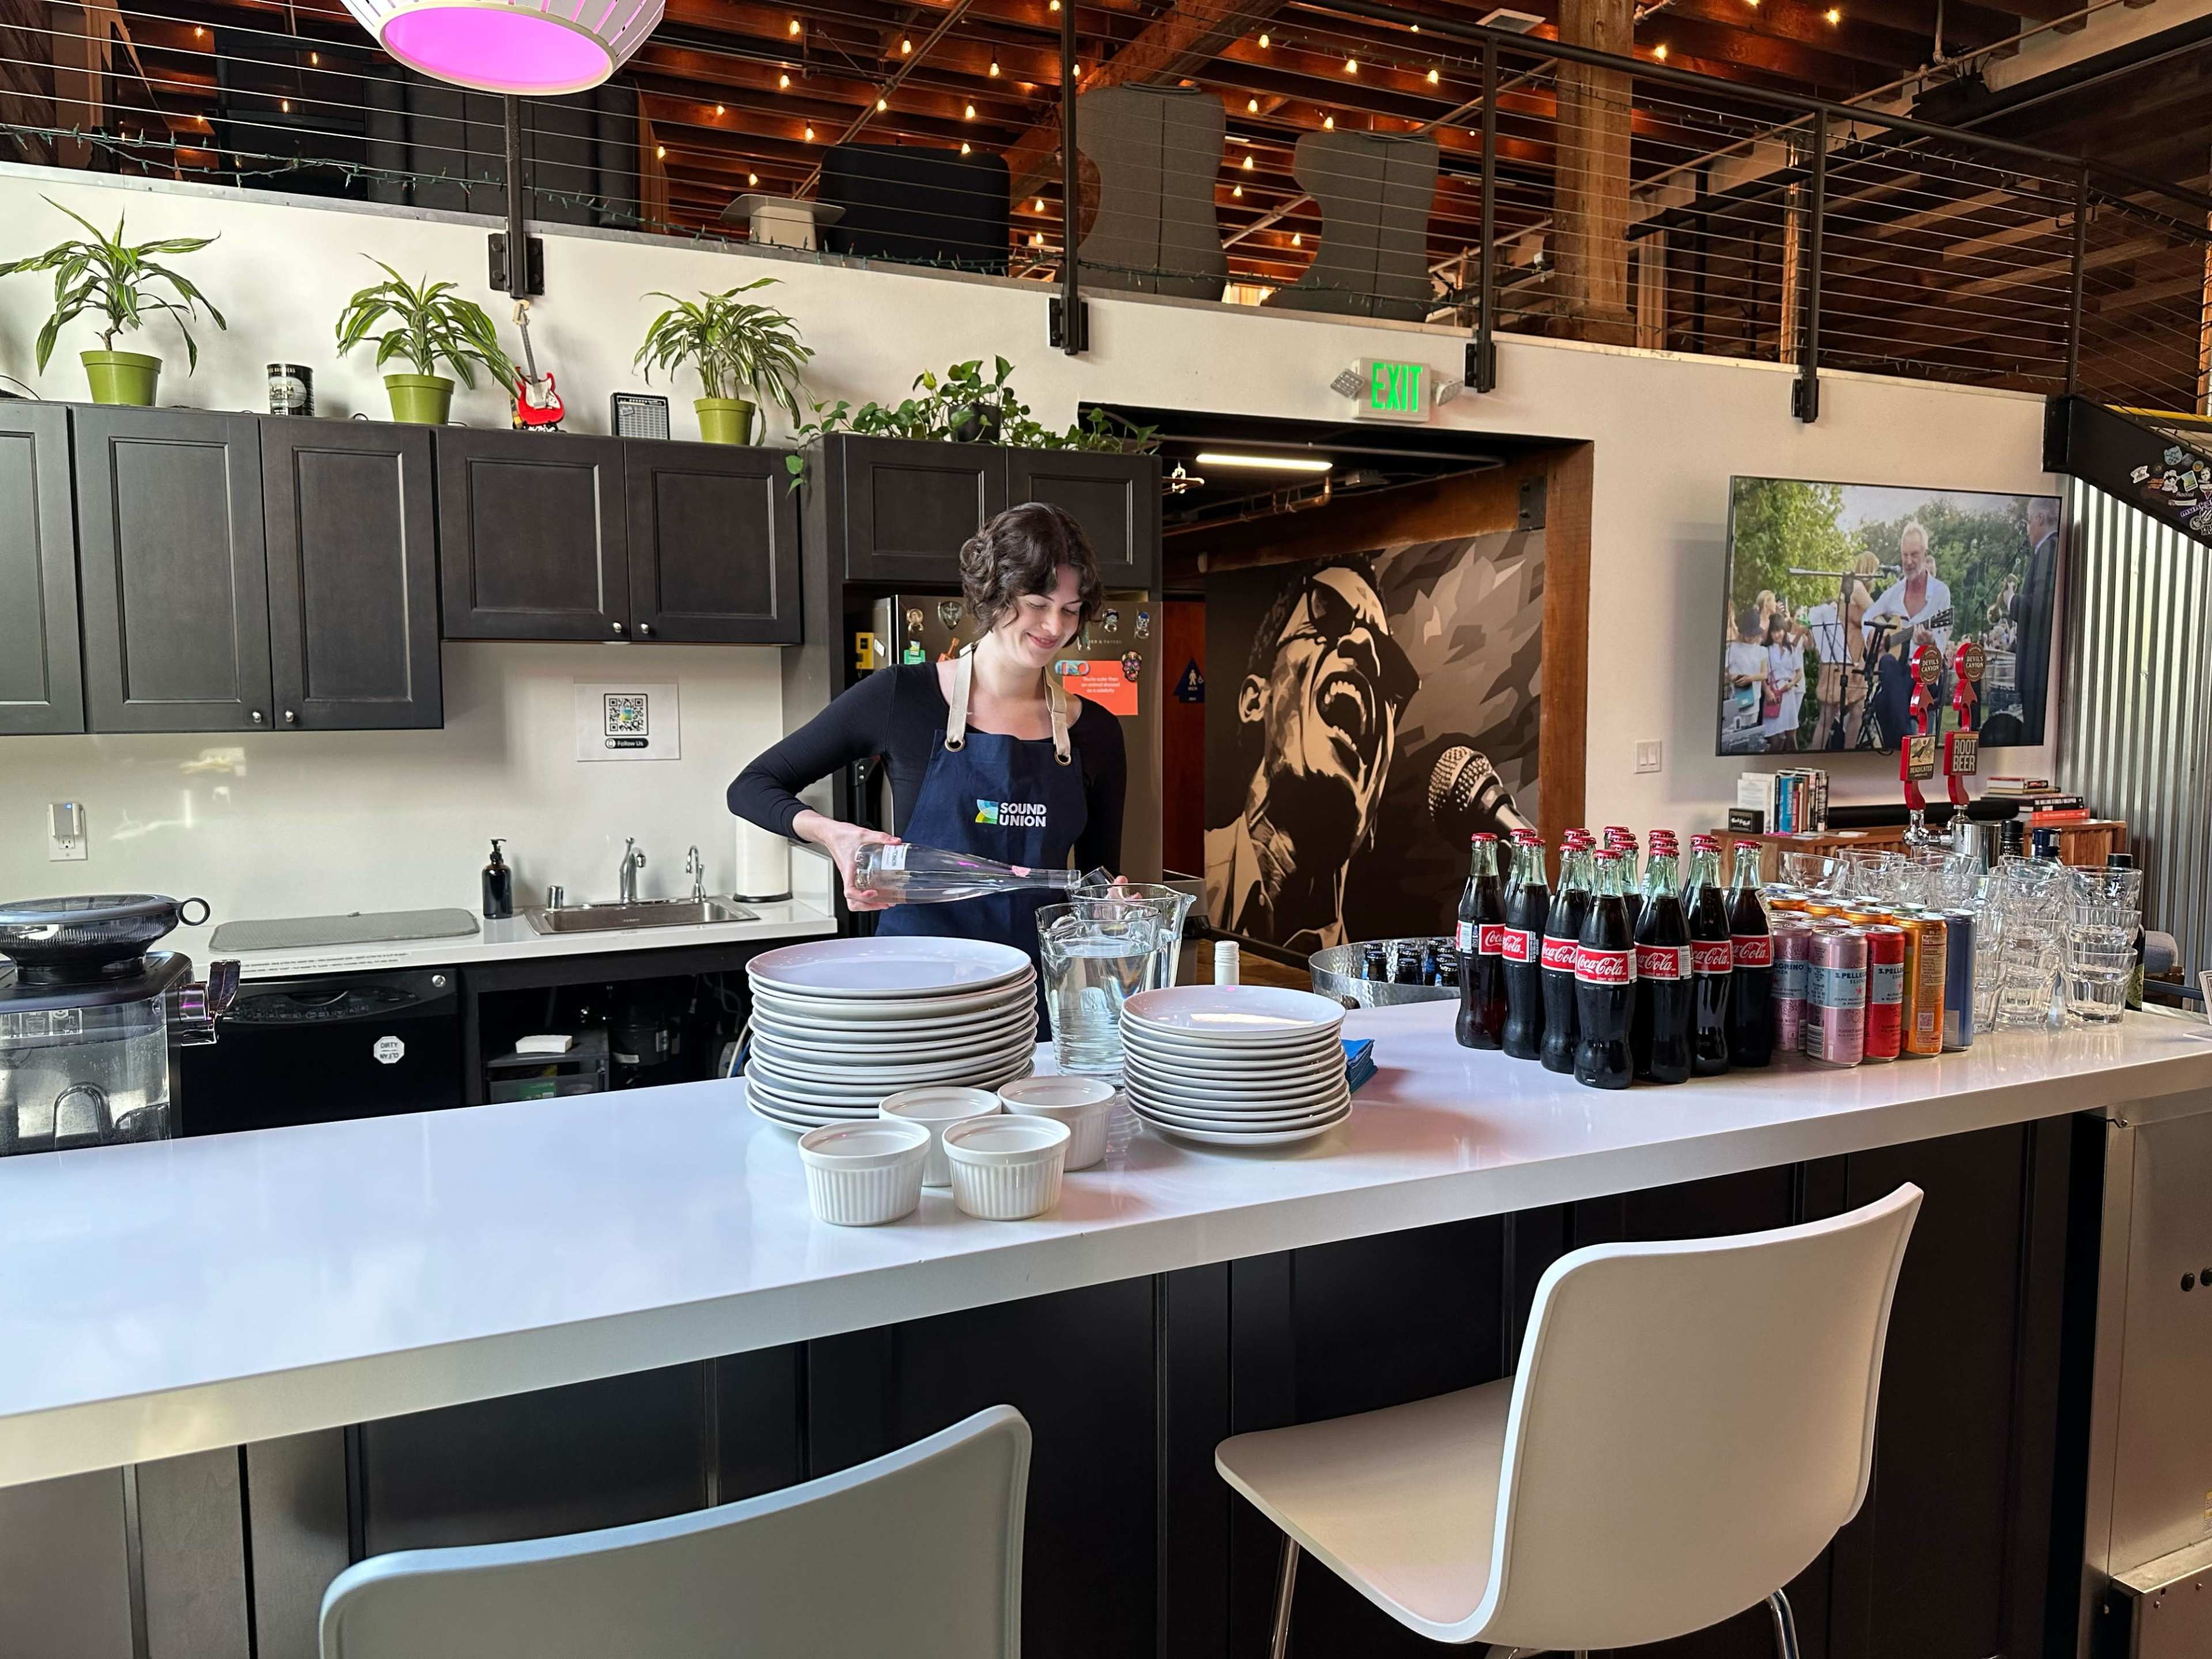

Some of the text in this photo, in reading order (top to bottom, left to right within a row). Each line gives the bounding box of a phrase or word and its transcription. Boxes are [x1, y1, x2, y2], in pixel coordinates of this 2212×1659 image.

[1372, 362, 1423, 412] EXIT
[1954, 739, 1977, 755] ROOT
[1953, 755, 1975, 772] BEER
[999, 802, 1047, 815] SOUND
[999, 814, 1047, 827] UNION
[1577, 954, 1624, 975] Coca-Cola
